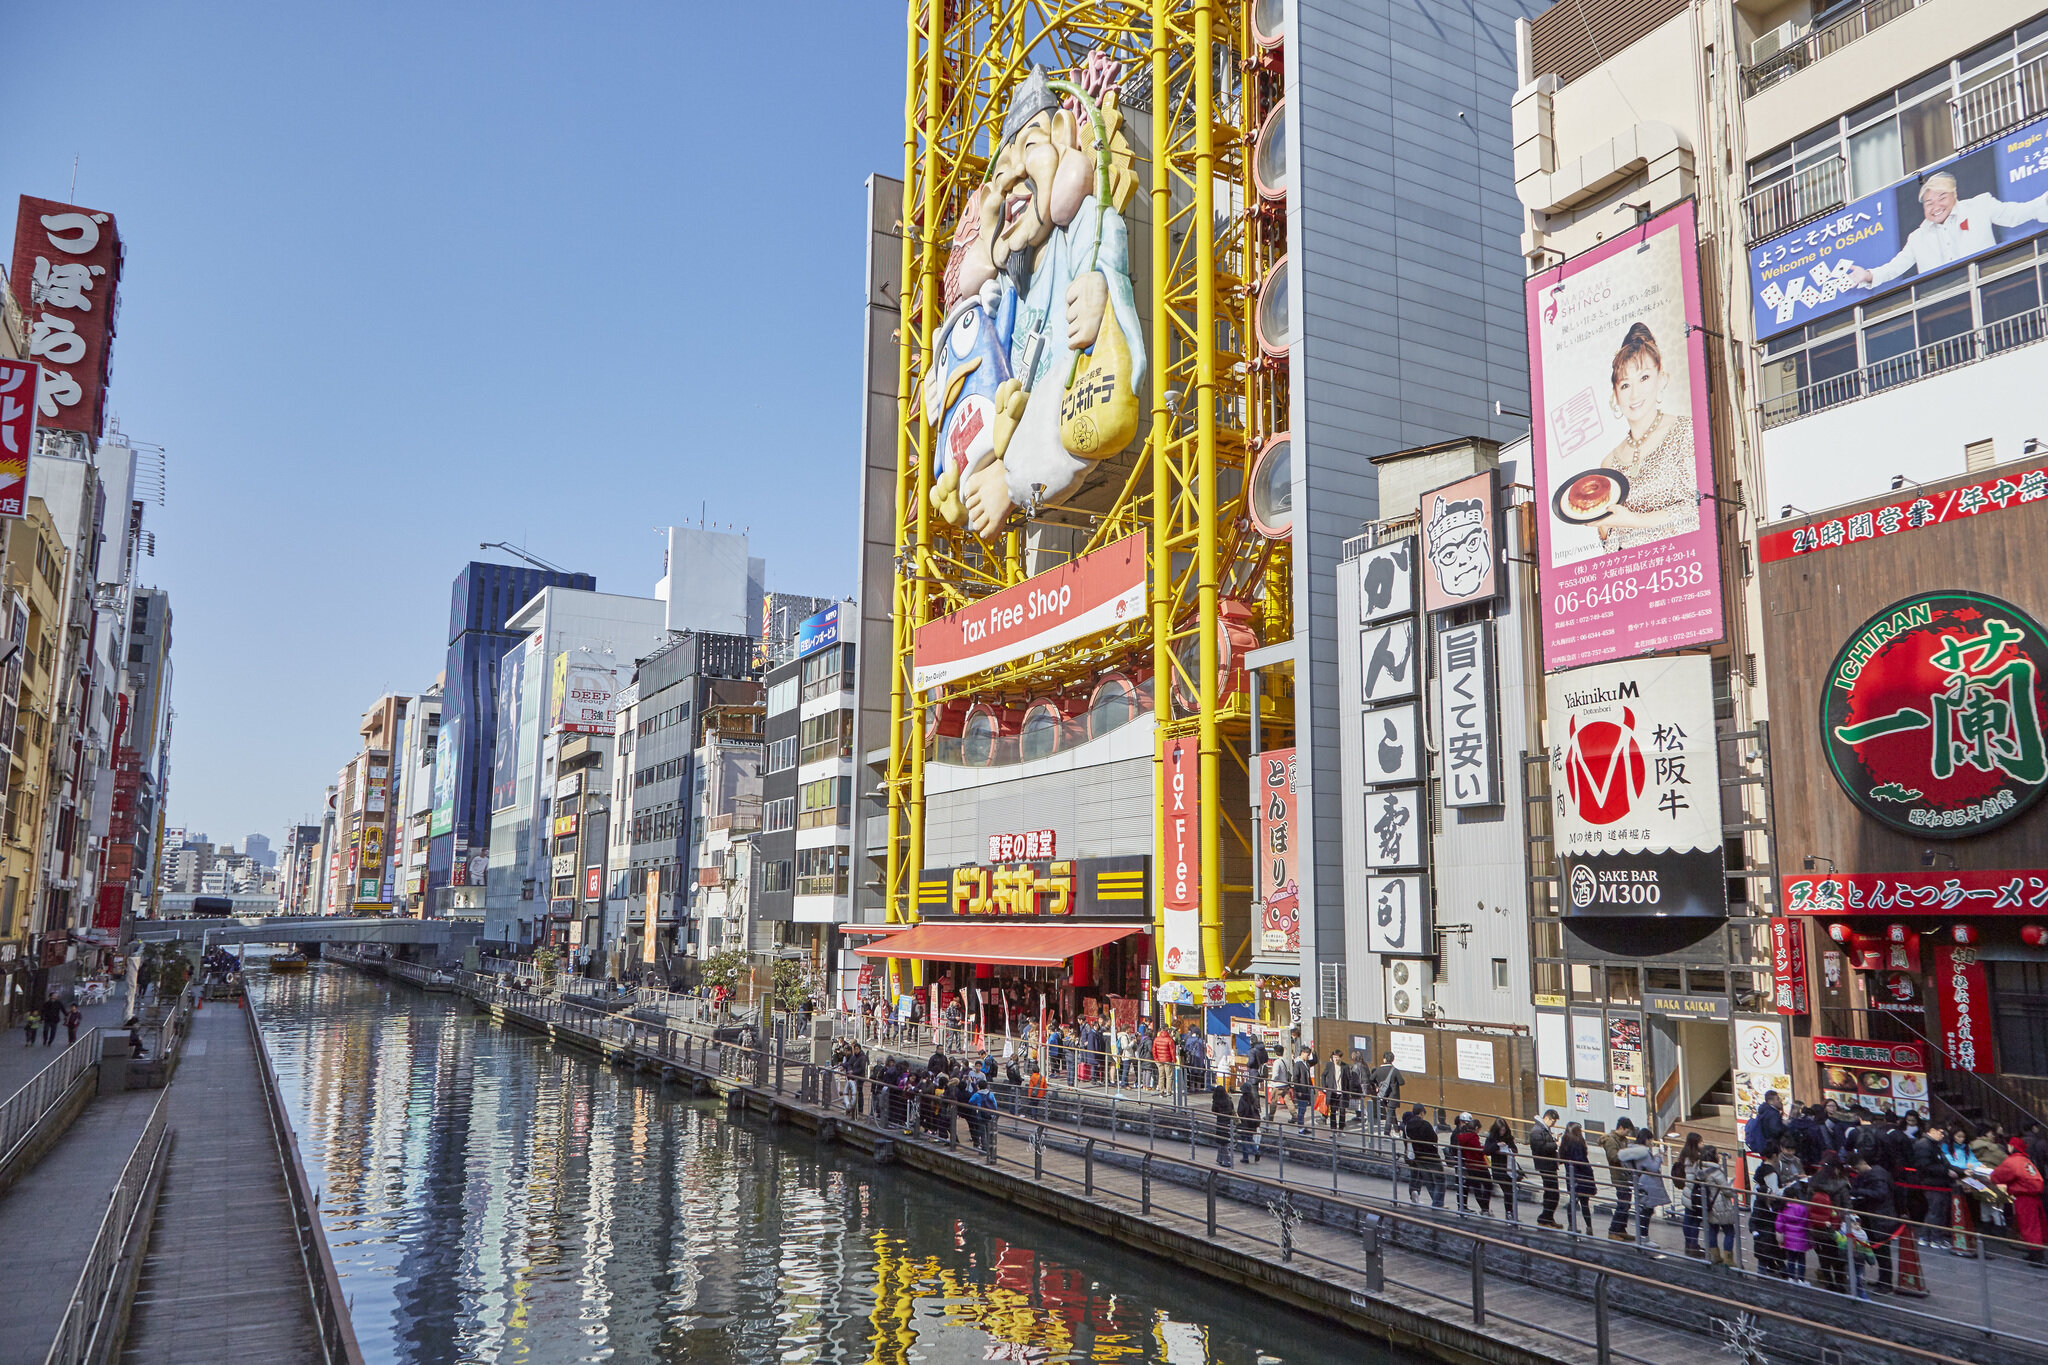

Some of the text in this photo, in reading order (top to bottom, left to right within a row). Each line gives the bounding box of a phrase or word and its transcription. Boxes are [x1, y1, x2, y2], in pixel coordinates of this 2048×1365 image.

[2008, 134, 2042, 153] Magic
[1761, 222, 1884, 281] Welcome to OSAKA
[1561, 288, 1611, 318] SHINCO
[1602, 557, 1664, 580] 大阪市福島区吉野
[1665, 549, 1697, 564] 4-20-14
[1554, 561, 1704, 615] 06-6468-4538
[962, 584, 1071, 645] Tax Free Shop
[1834, 602, 1933, 691] ICHIRAN
[571, 690, 612, 701] DEEP
[1564, 680, 1640, 709] Yakiniku M
[1834, 619, 2048, 785] 一蘭
[1446, 631, 1483, 800] 旨くて安い
[1583, 706, 1612, 716] Dotonbori
[1552, 743, 1567, 818] 焼肉
[1652, 723, 1692, 820] 松阪牛
[1172, 749, 1187, 900] Tax Free
[1267, 758, 1290, 889] とんぼり
[1908, 790, 2017, 828] 昭和35年創業
[989, 830, 1053, 862] 驚安の殿堂
[1607, 829, 1651, 842] 道頓堀店
[1599, 870, 1659, 882] SAKE BAR
[1574, 882, 1591, 904] 酒
[1599, 884, 1661, 904] M300
[1654, 998, 1716, 1013] INAKA KAIKAN
[1815, 1043, 1891, 1063] お土産販売所
